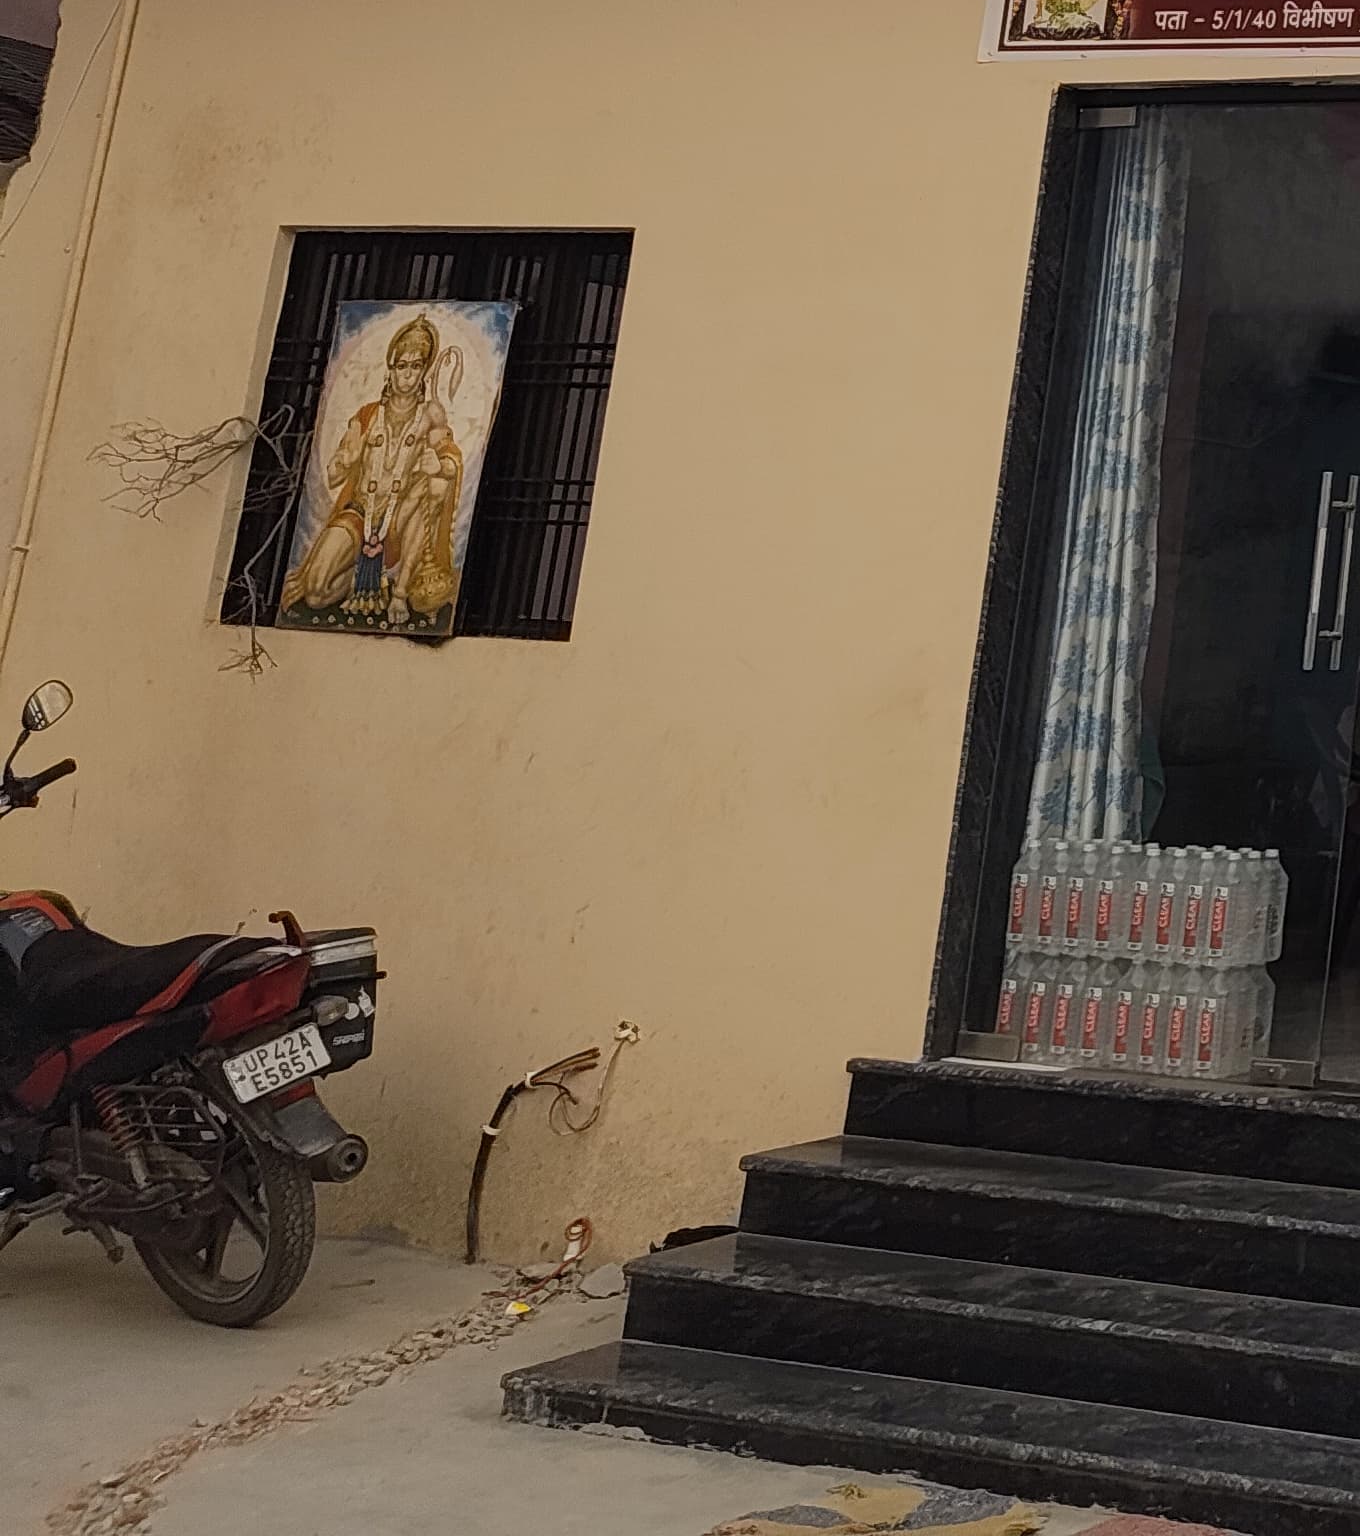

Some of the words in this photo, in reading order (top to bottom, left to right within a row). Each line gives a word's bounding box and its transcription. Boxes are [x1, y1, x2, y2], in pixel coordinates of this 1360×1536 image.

[1155, 10, 1188, 31] पता
[1211, 9, 1277, 31] 5/1/40
[1282, 0, 1354, 30] विभीषण
[243, 1048, 269, 1073] UP
[274, 1031, 313, 1061] 42A
[250, 1049, 318, 1094] E5851
